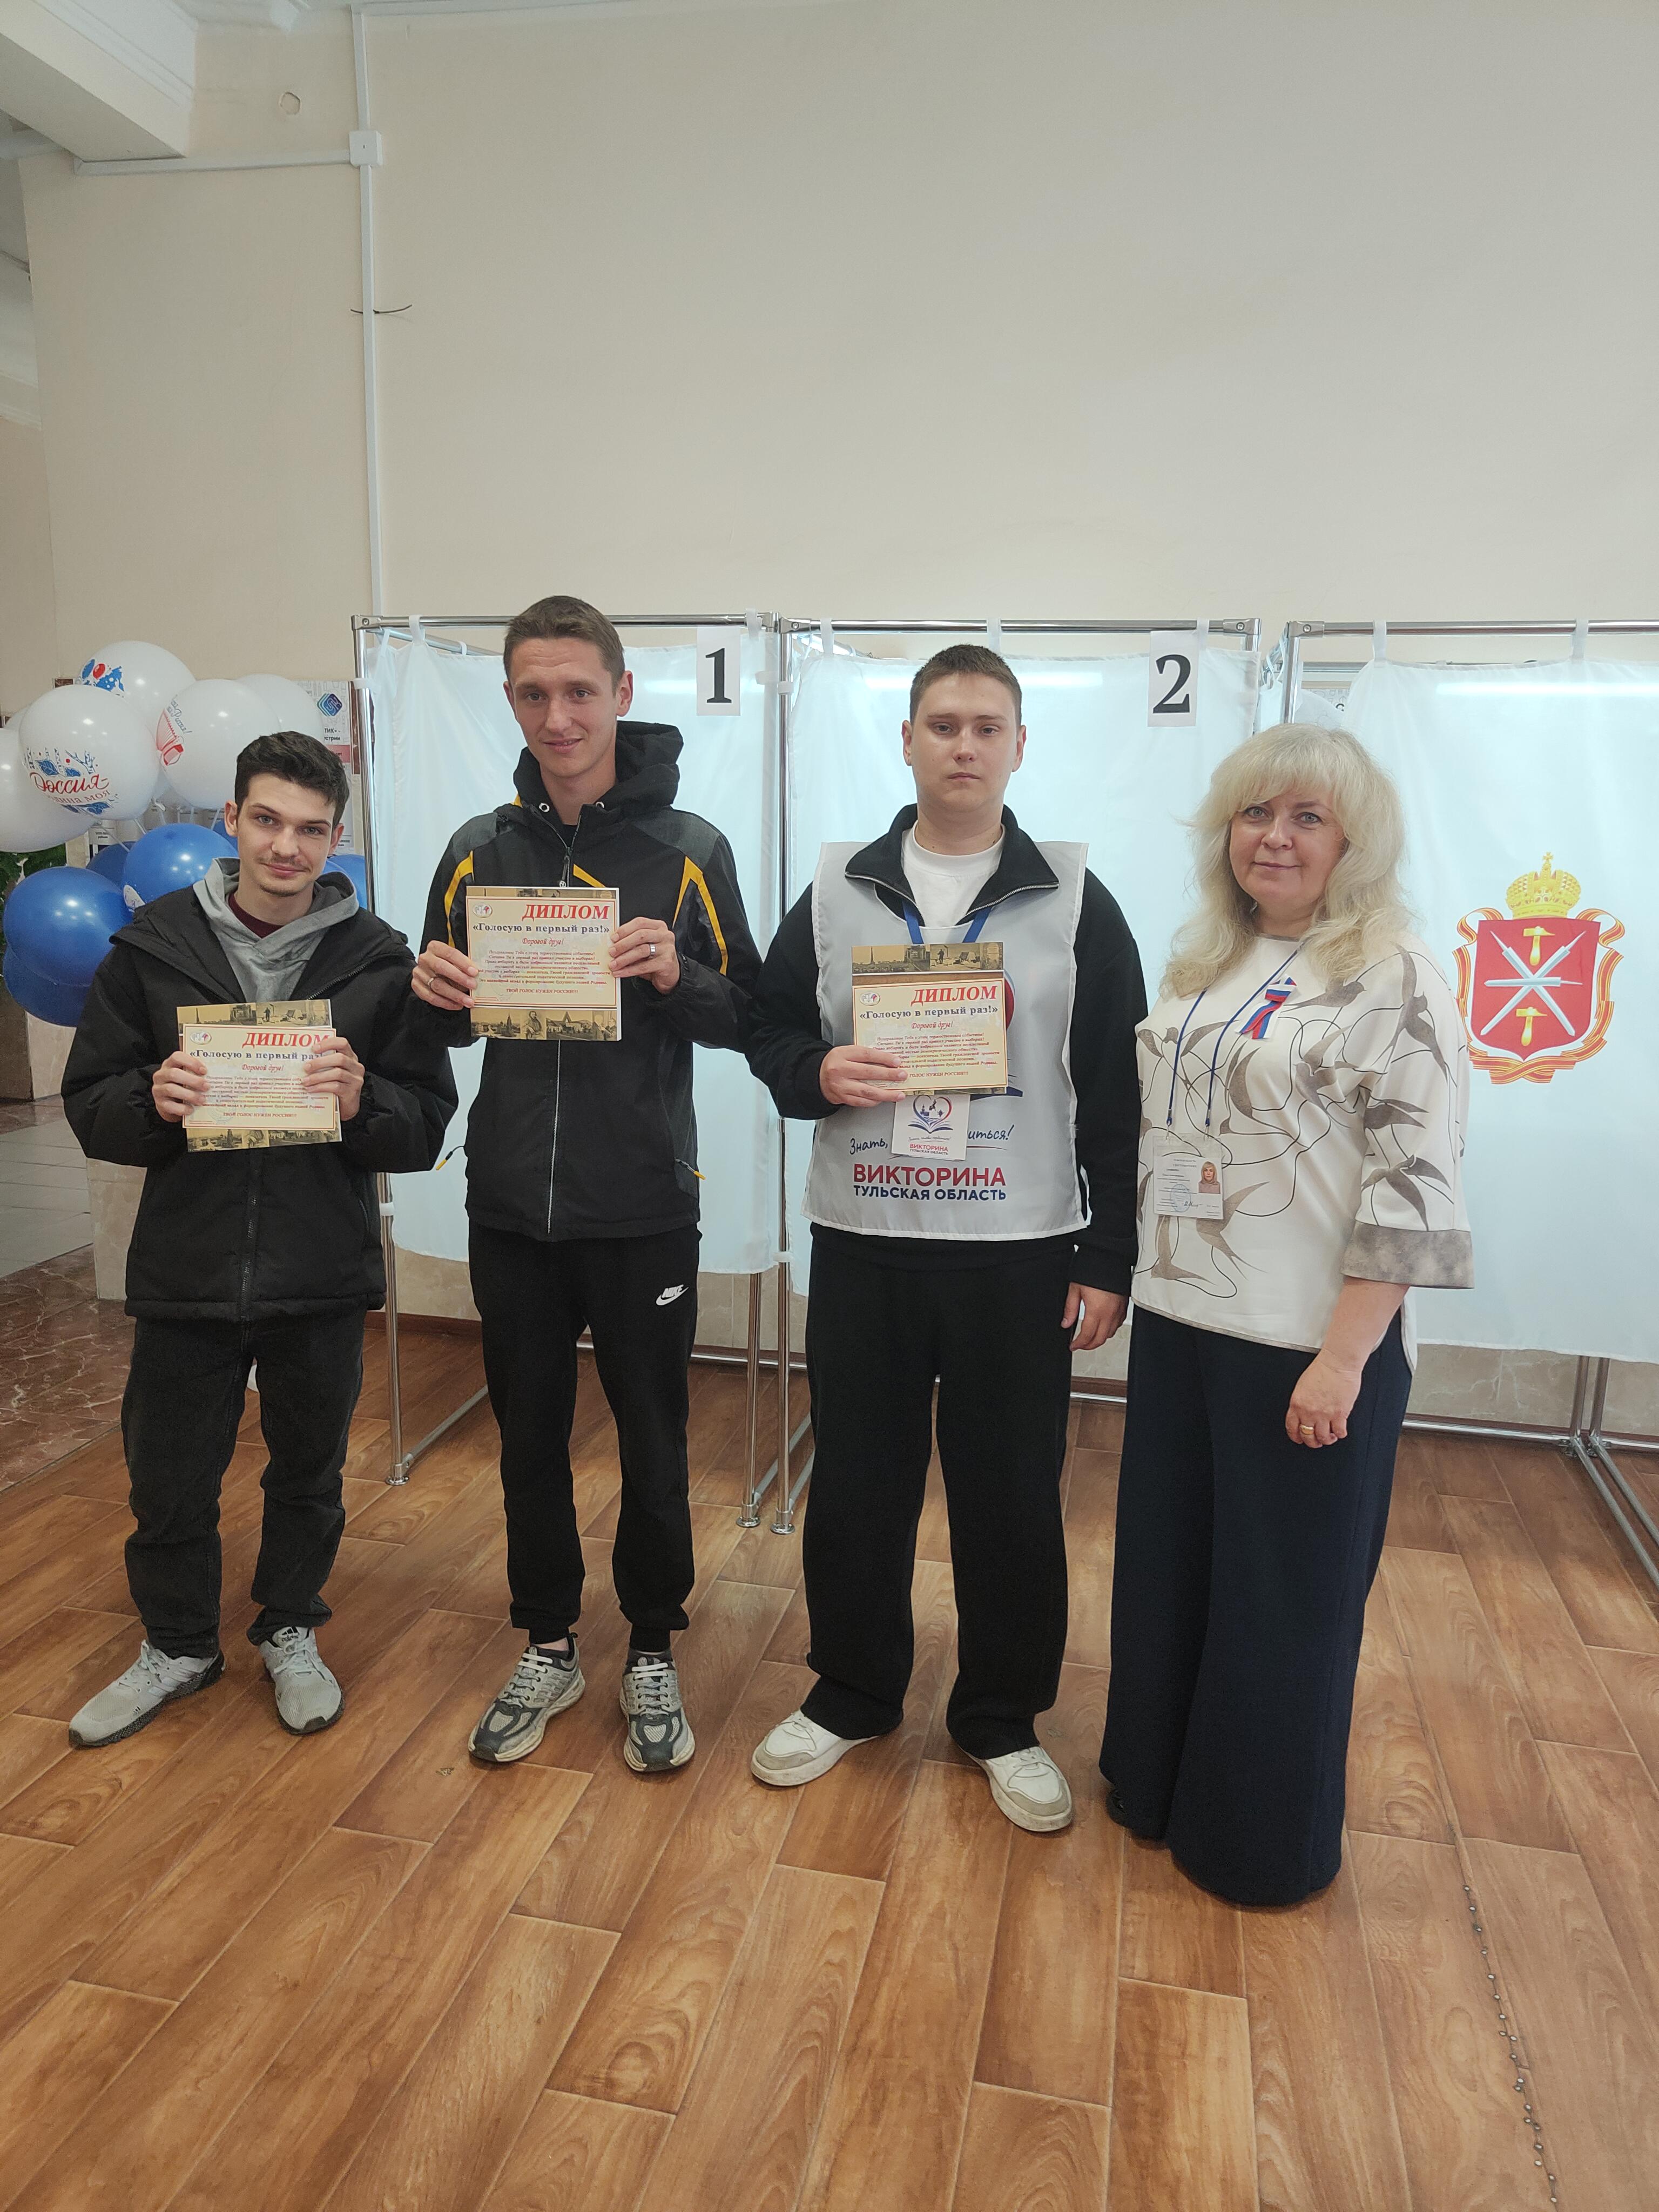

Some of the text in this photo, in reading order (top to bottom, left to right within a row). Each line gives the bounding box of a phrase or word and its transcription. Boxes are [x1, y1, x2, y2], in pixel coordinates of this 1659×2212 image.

[705, 648, 732, 704] 1
[1152, 654, 1191, 714] 2
[84, 790, 111, 802] моя
[522, 904, 610, 921] ДИПЛОМ
[473, 923, 522, 934] «Голосую
[535, 925, 577, 934] первый
[581, 924, 610, 934] раз!»
[522, 938, 547, 947] Дорогой
[911, 985, 998, 1006] ДИПЛОМ
[859, 1010, 911, 1020] «Голосую
[925, 1007, 966, 1018] первый
[970, 1005, 998, 1015] раз!»
[911, 1022, 936, 1030] Дорогой
[190, 1049, 242, 1060] «Голосую
[256, 1053, 298, 1061] первый
[849, 1124, 1015, 1155] Знать, иться!
[909, 1143, 949, 1152] ВИКТОРИНА
[853, 1163, 1006, 1186] ВИКТОРИНА
[853, 1185, 1007, 1201] ТУЛЬСКАЯ ОБЛАСТЬ
[661, 1284, 684, 1298] NIKE
